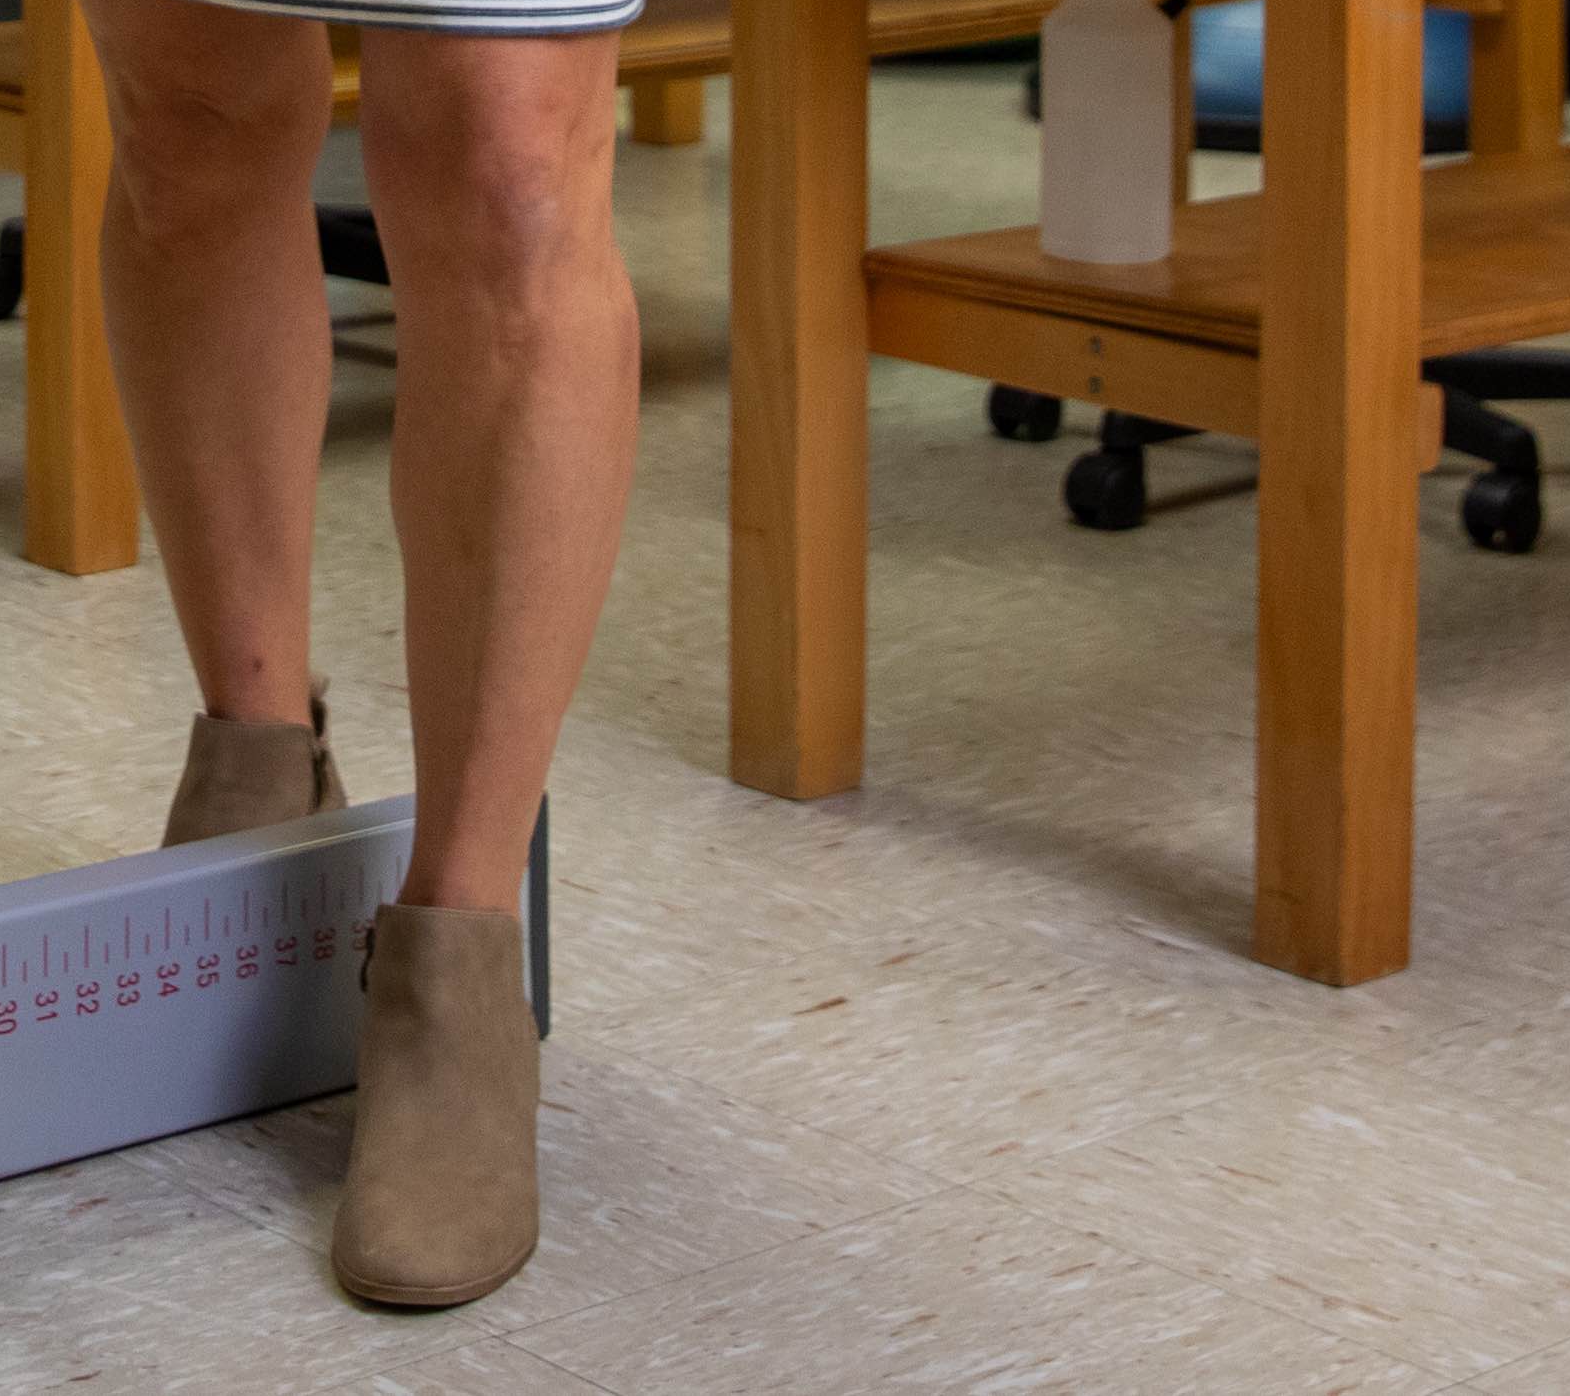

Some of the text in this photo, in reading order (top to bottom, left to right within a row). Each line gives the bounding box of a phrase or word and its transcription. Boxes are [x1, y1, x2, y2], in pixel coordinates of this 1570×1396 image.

[157, 963, 180, 997] 34
[197, 954, 220, 988] 35
[76, 981, 99, 1015] 32
[117, 972, 140, 1006] 33
[35, 991, 58, 1022] 31
